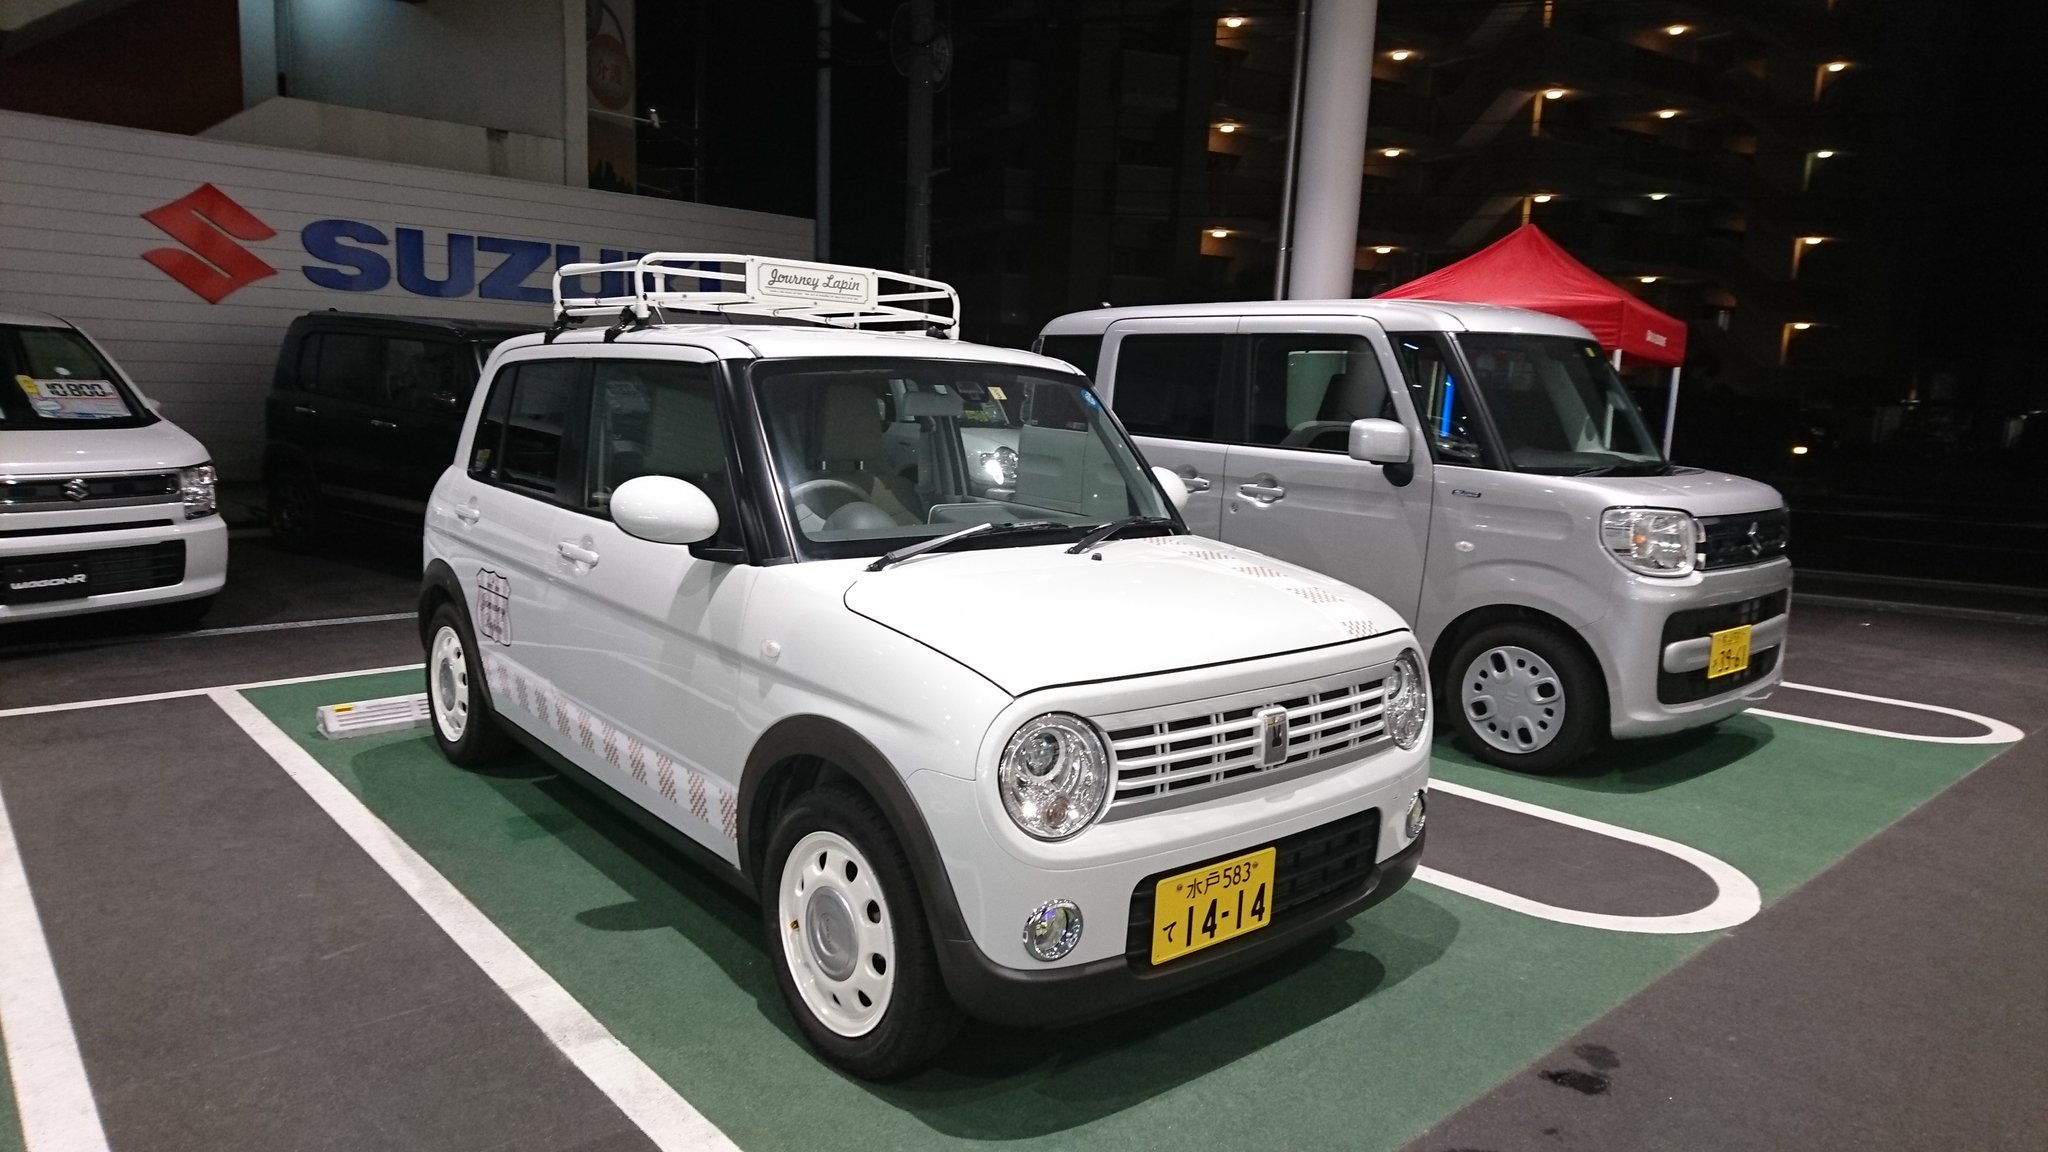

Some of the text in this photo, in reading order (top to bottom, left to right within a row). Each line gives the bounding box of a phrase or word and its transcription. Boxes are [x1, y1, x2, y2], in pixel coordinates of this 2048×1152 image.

[768, 268, 861, 294] Journey Lapin
[1162, 882, 1266, 947] て 14-14
